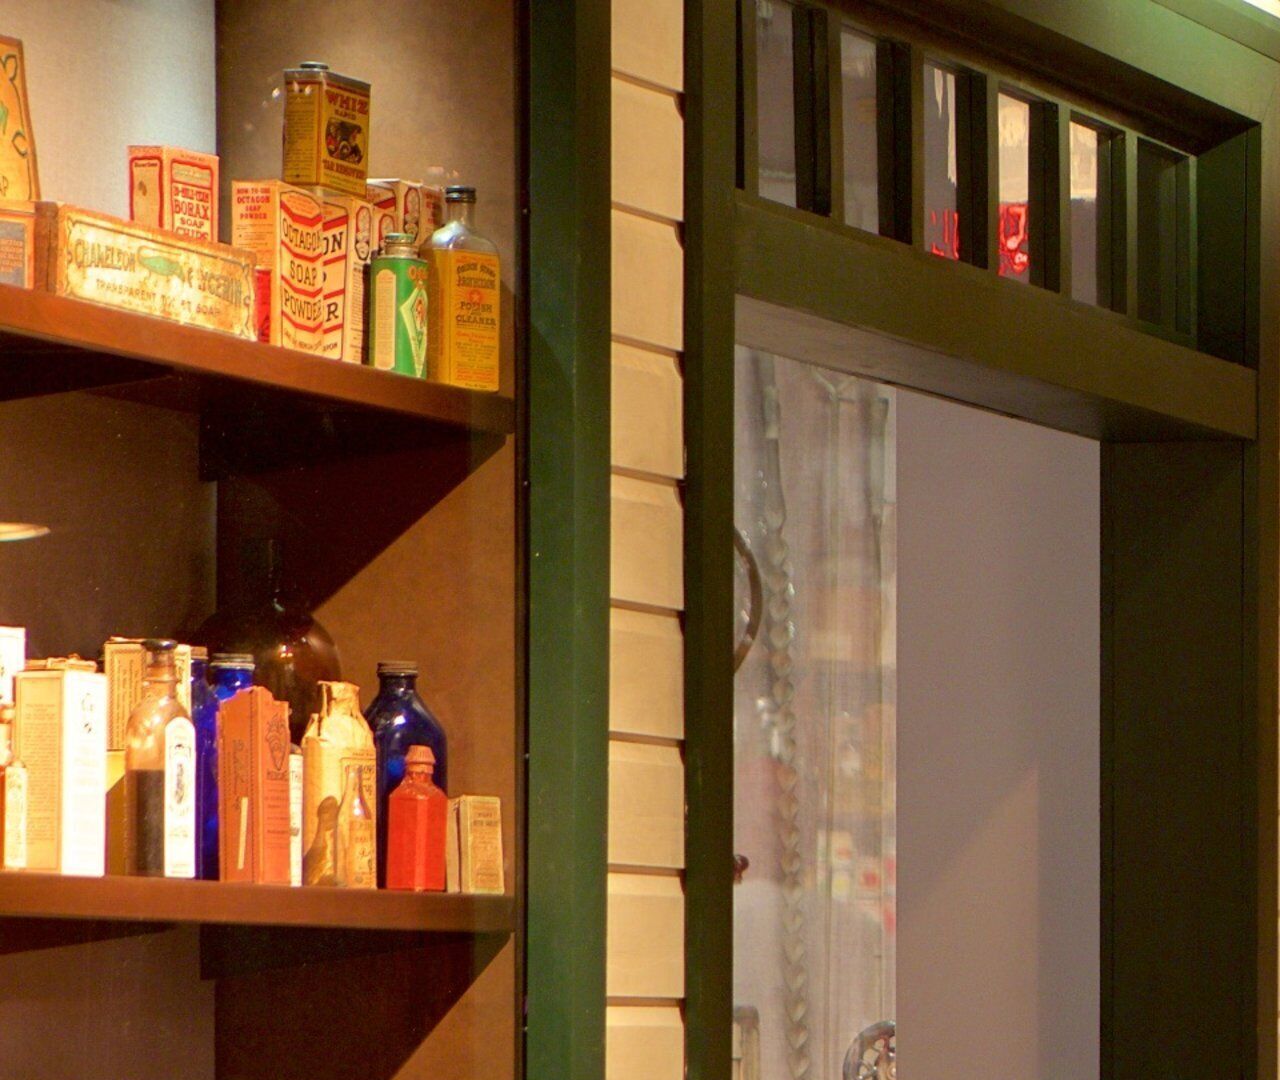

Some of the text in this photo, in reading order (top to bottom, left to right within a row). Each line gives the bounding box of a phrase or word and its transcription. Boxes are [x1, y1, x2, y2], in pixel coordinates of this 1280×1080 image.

[325, 88, 369, 115] WHIZ
[174, 200, 209, 221] BORAX
[237, 196, 271, 204] OCTAGON
[180, 217, 205, 228] SOAP
[282, 218, 322, 252] OCTAGON
[75, 238, 136, 273] CHAMELEON
[290, 260, 318, 287] SOAP
[96, 279, 157, 302] TRANSPARENT
[284, 288, 322, 322] POWDER
[456, 315, 496, 326] CLEANER
